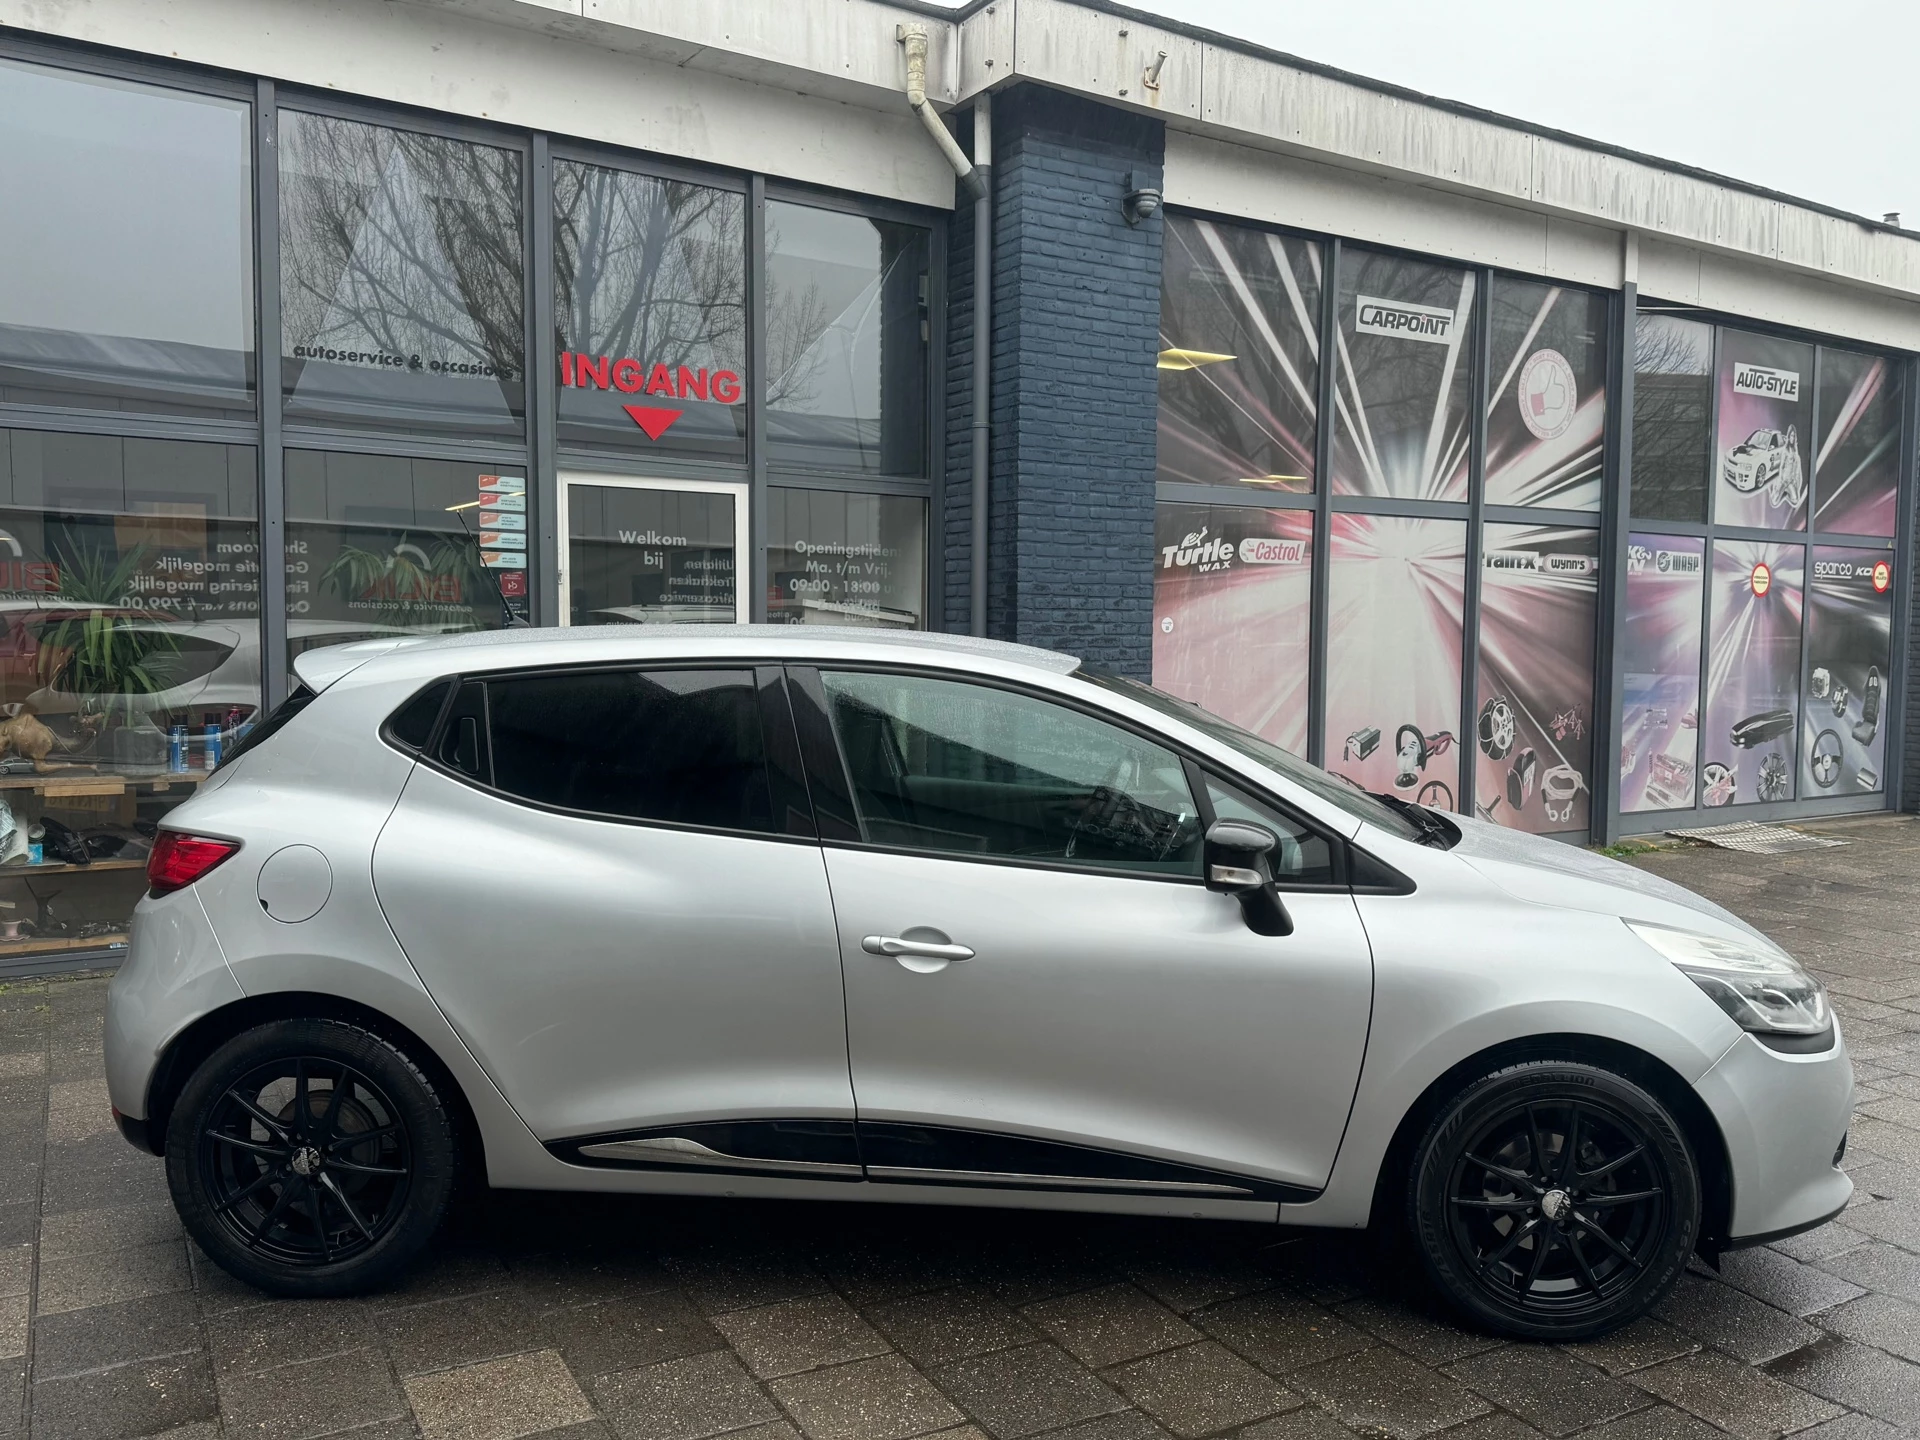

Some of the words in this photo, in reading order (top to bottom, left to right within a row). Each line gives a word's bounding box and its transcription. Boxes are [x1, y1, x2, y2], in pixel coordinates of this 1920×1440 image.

[1358, 304, 1451, 337] CARPOINT
[293, 343, 403, 368] autoservice
[408, 354, 423, 369] &
[429, 358, 514, 379] occasions
[561, 351, 742, 404] INGANG
[1735, 368, 1797, 396] AUTO-STYLE
[619, 531, 687, 546] Welkom
[794, 540, 902, 560] Openingstijden:
[1162, 537, 1235, 569] Turtle
[1255, 540, 1301, 562] Castrol
[643, 551, 664, 570] bij
[805, 560, 832, 574] Ma.
[836, 560, 861, 576] t/m
[864, 562, 892, 579] Vrij.
[1198, 561, 1232, 573] WAX
[1672, 555, 1698, 572] WASP
[1814, 561, 1852, 579] sparco
[789, 579, 830, 592] 09:00
[843, 580, 881, 594] 18:00
